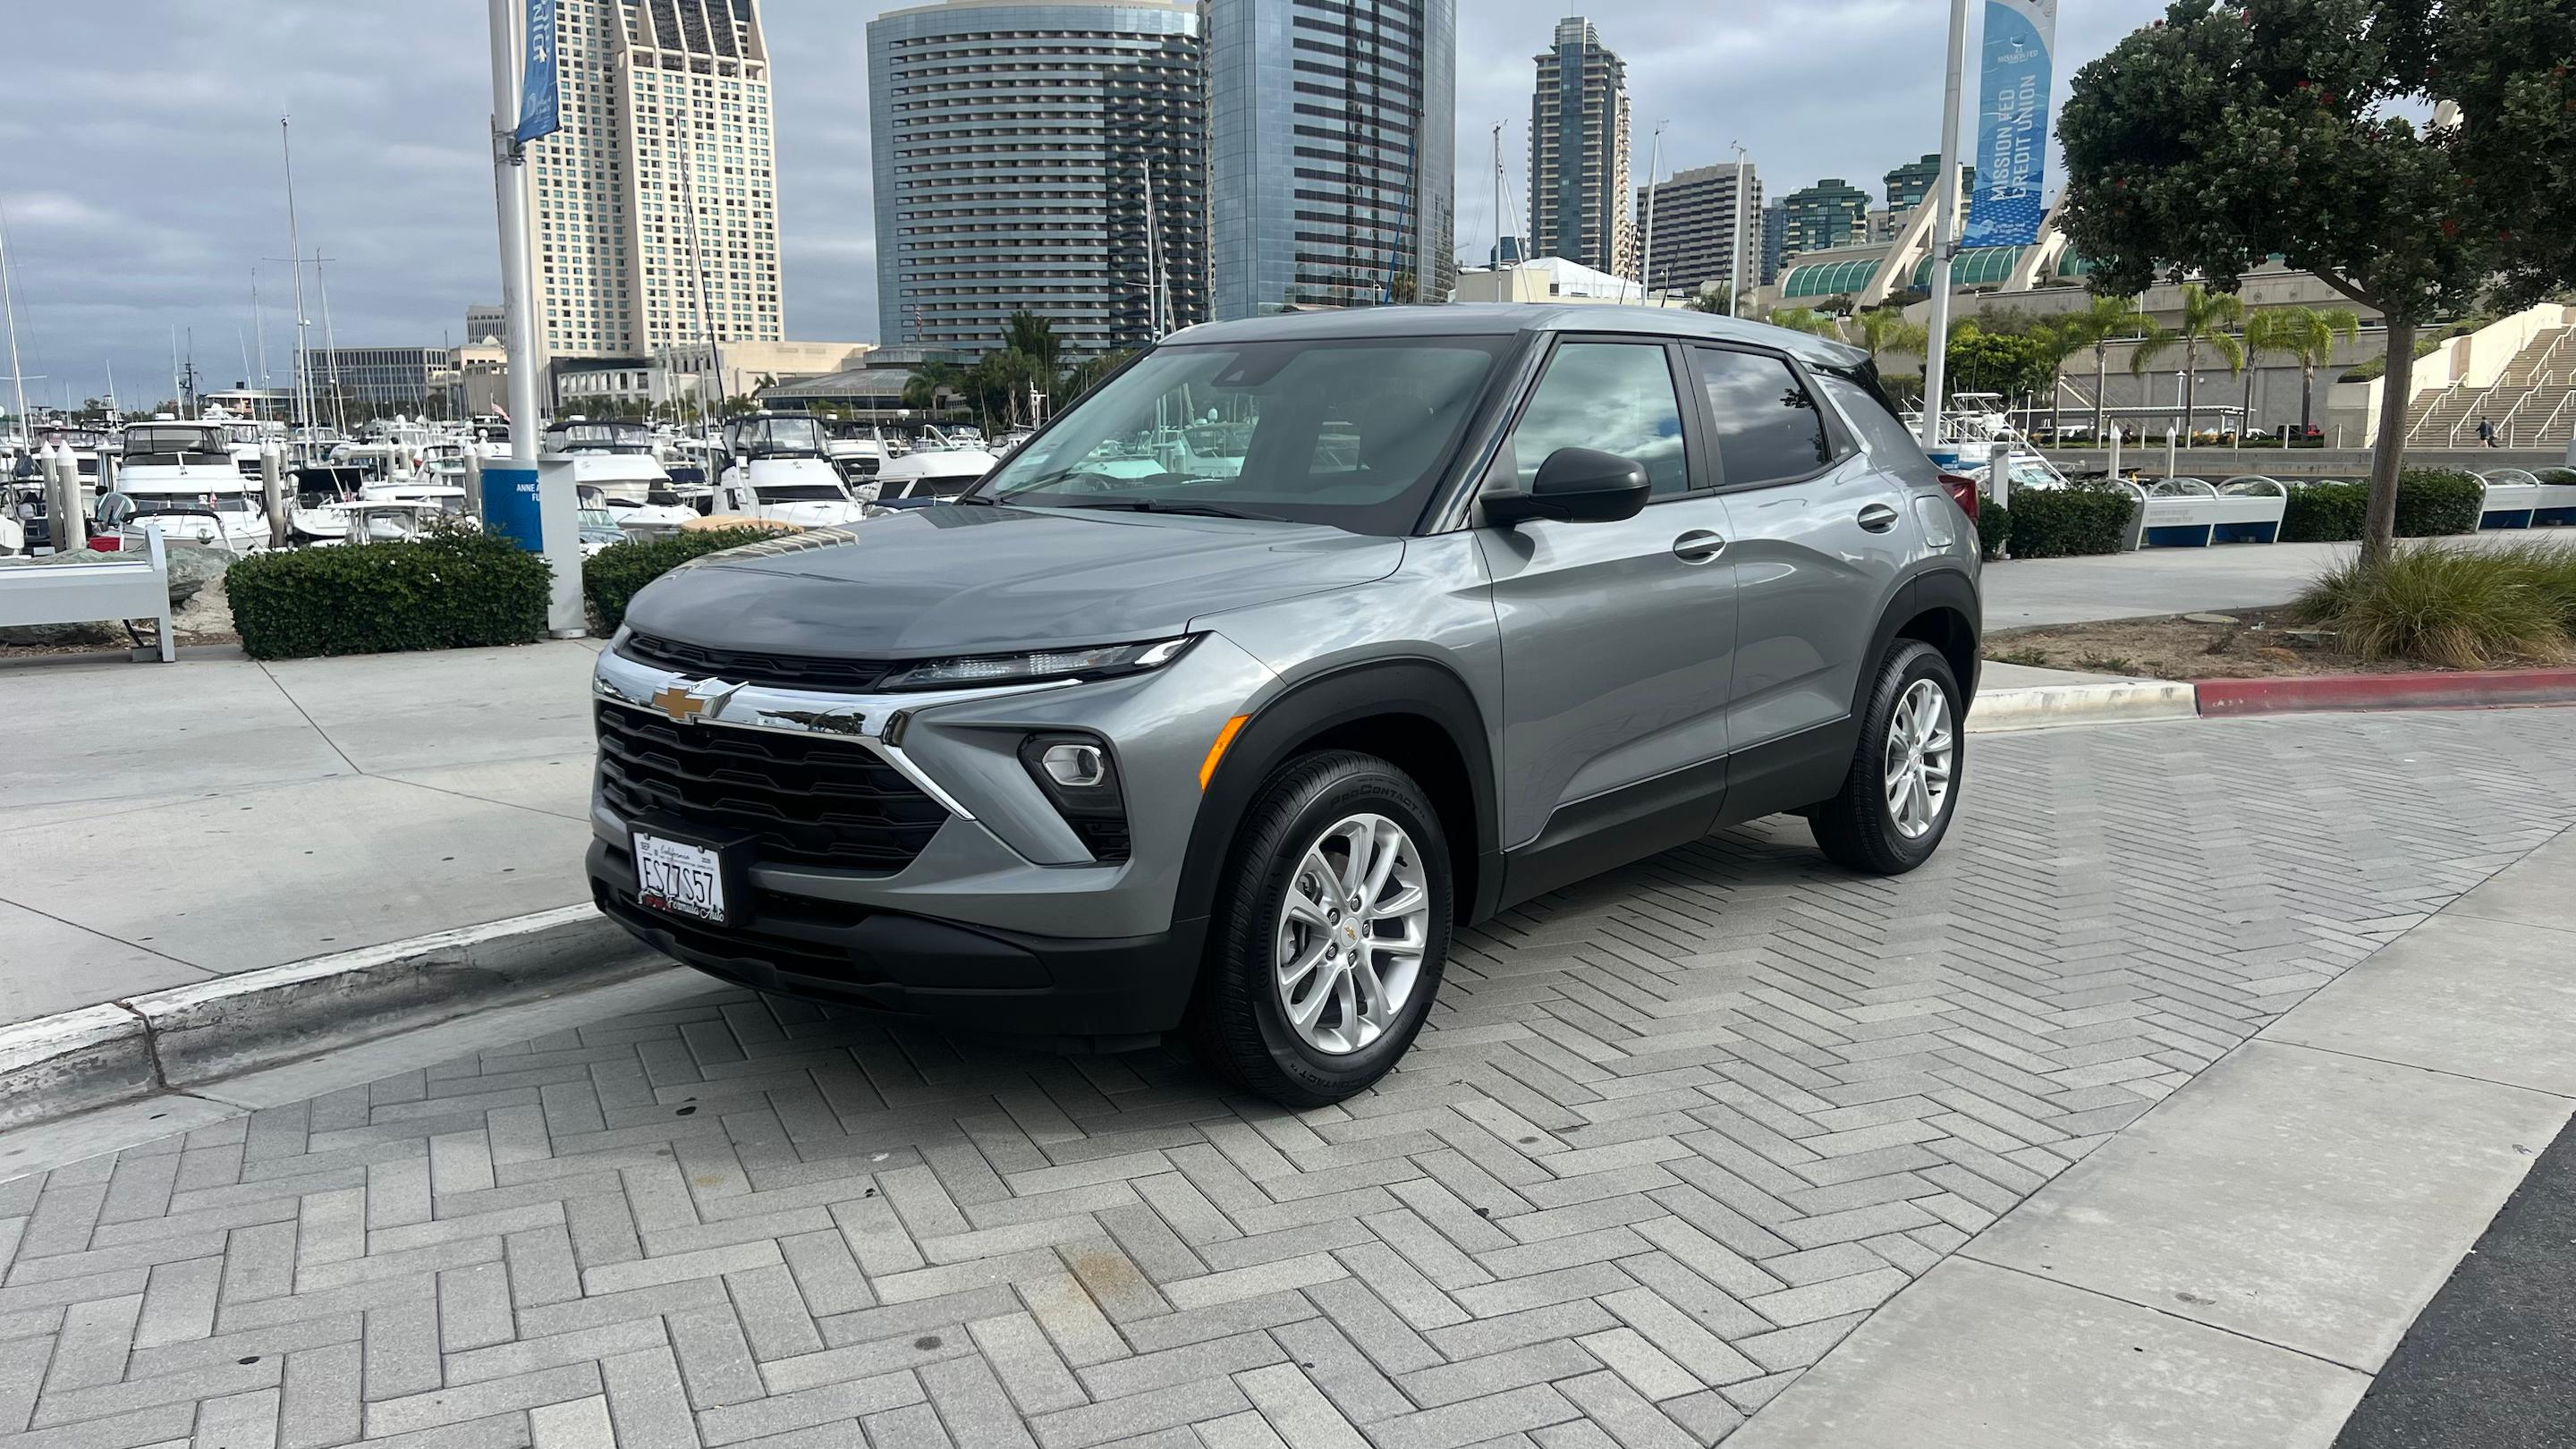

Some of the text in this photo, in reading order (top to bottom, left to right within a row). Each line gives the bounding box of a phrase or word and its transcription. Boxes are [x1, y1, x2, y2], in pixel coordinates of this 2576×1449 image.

[1998, 89, 2015, 123] FED
[2018, 74, 2037, 131] UNION
[1990, 127, 2012, 201] MISSION
[2009, 133, 2031, 199] CREDIT
[516, 484, 535, 492] ANNE
[660, 844, 691, 861] California
[643, 857, 713, 905] ES77S57
[665, 895, 700, 916] Formula
[700, 905, 724, 922] Auto
